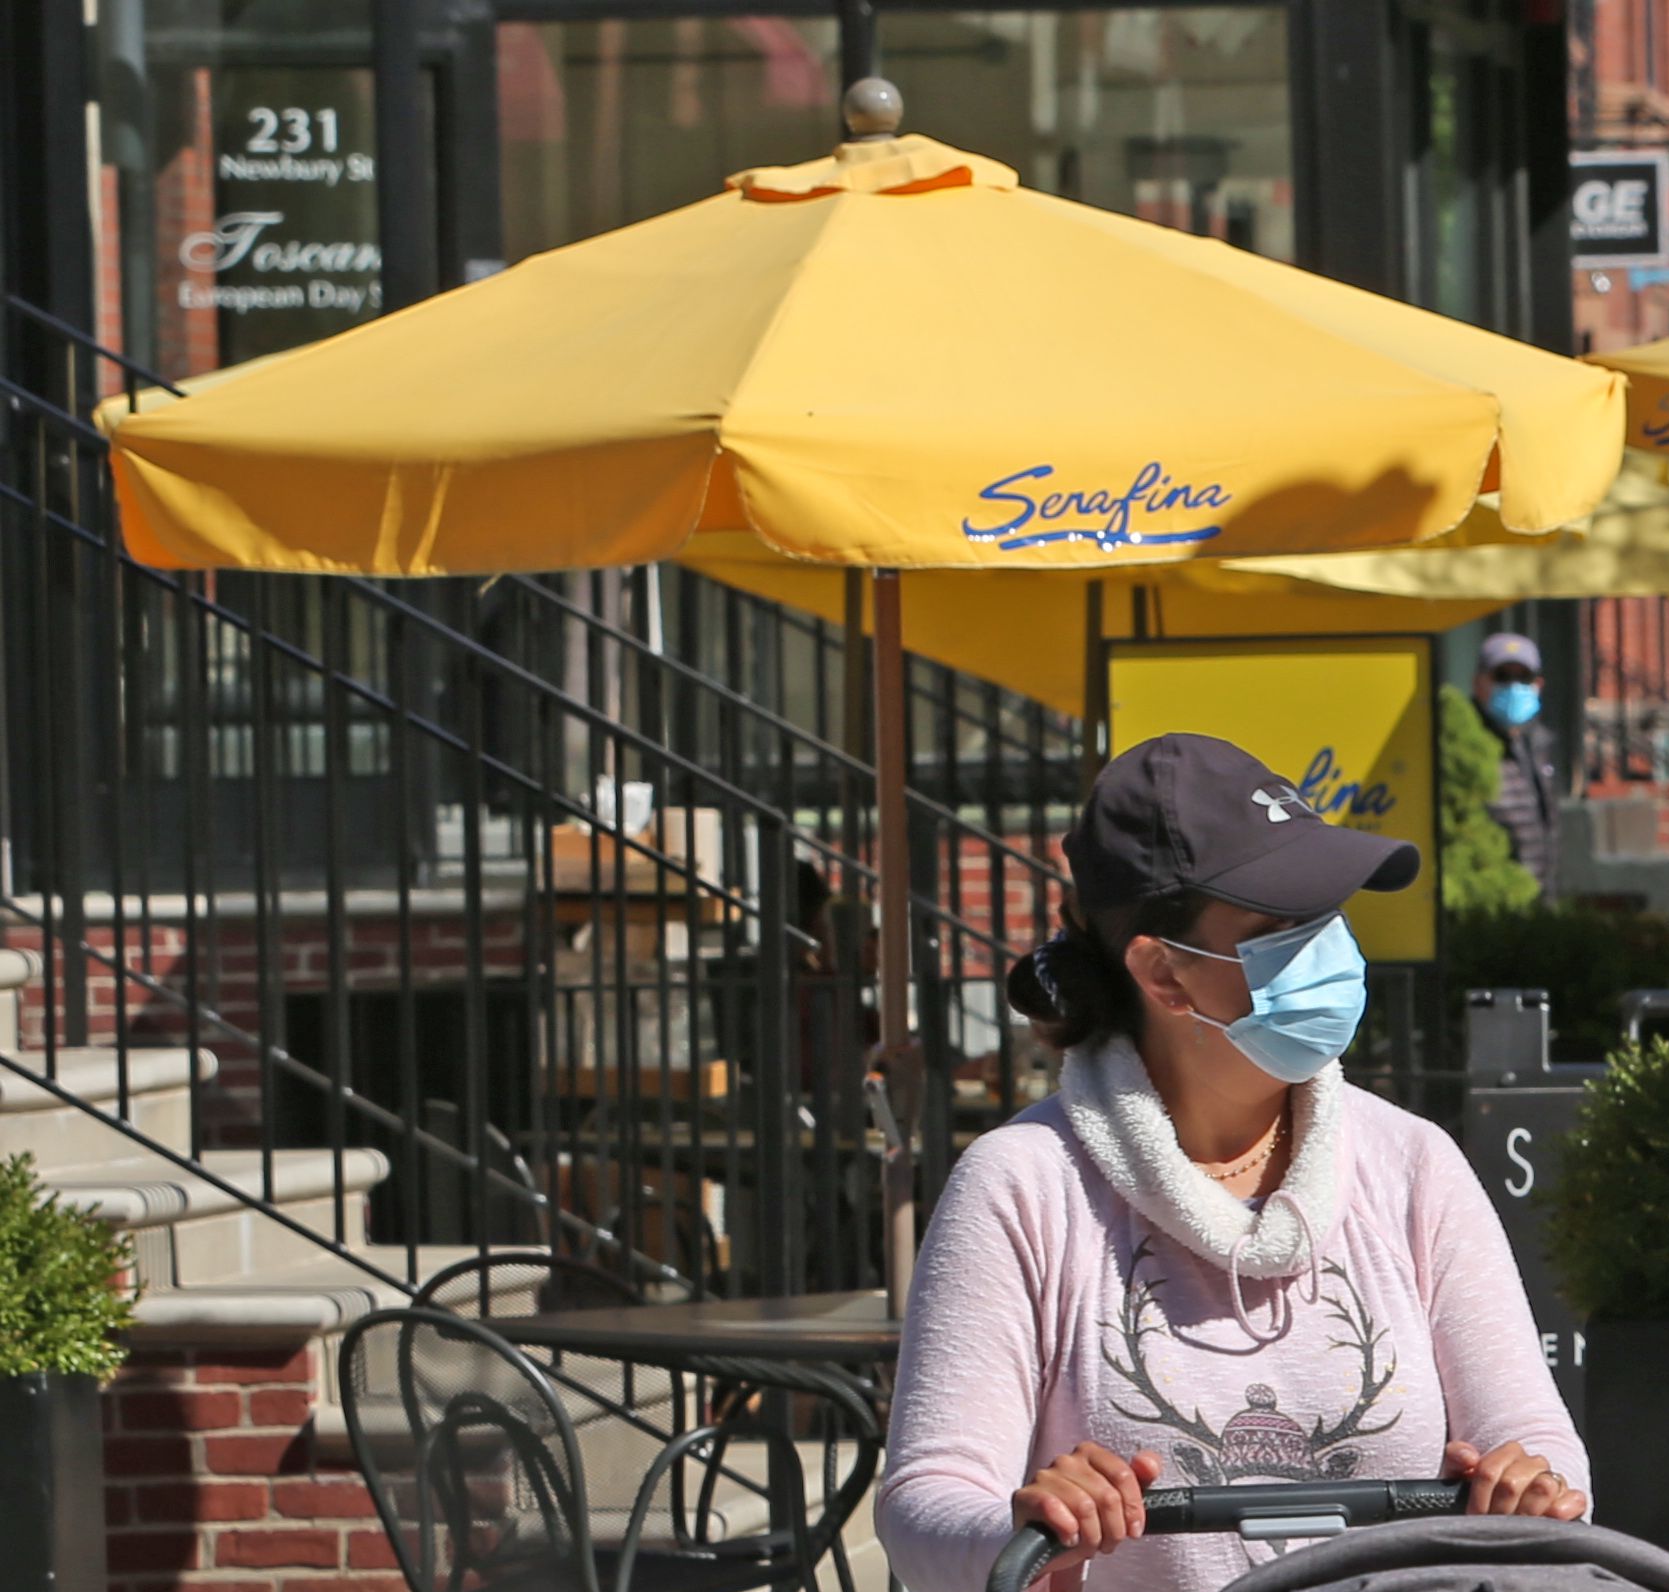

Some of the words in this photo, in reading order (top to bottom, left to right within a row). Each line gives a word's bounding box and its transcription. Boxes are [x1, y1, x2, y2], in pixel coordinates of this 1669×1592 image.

[246, 106, 338, 153] 231
[219, 152, 344, 188] Newbury
[177, 278, 305, 315] European
[308, 278, 367, 315] Day
[962, 461, 1232, 552] Serafina
